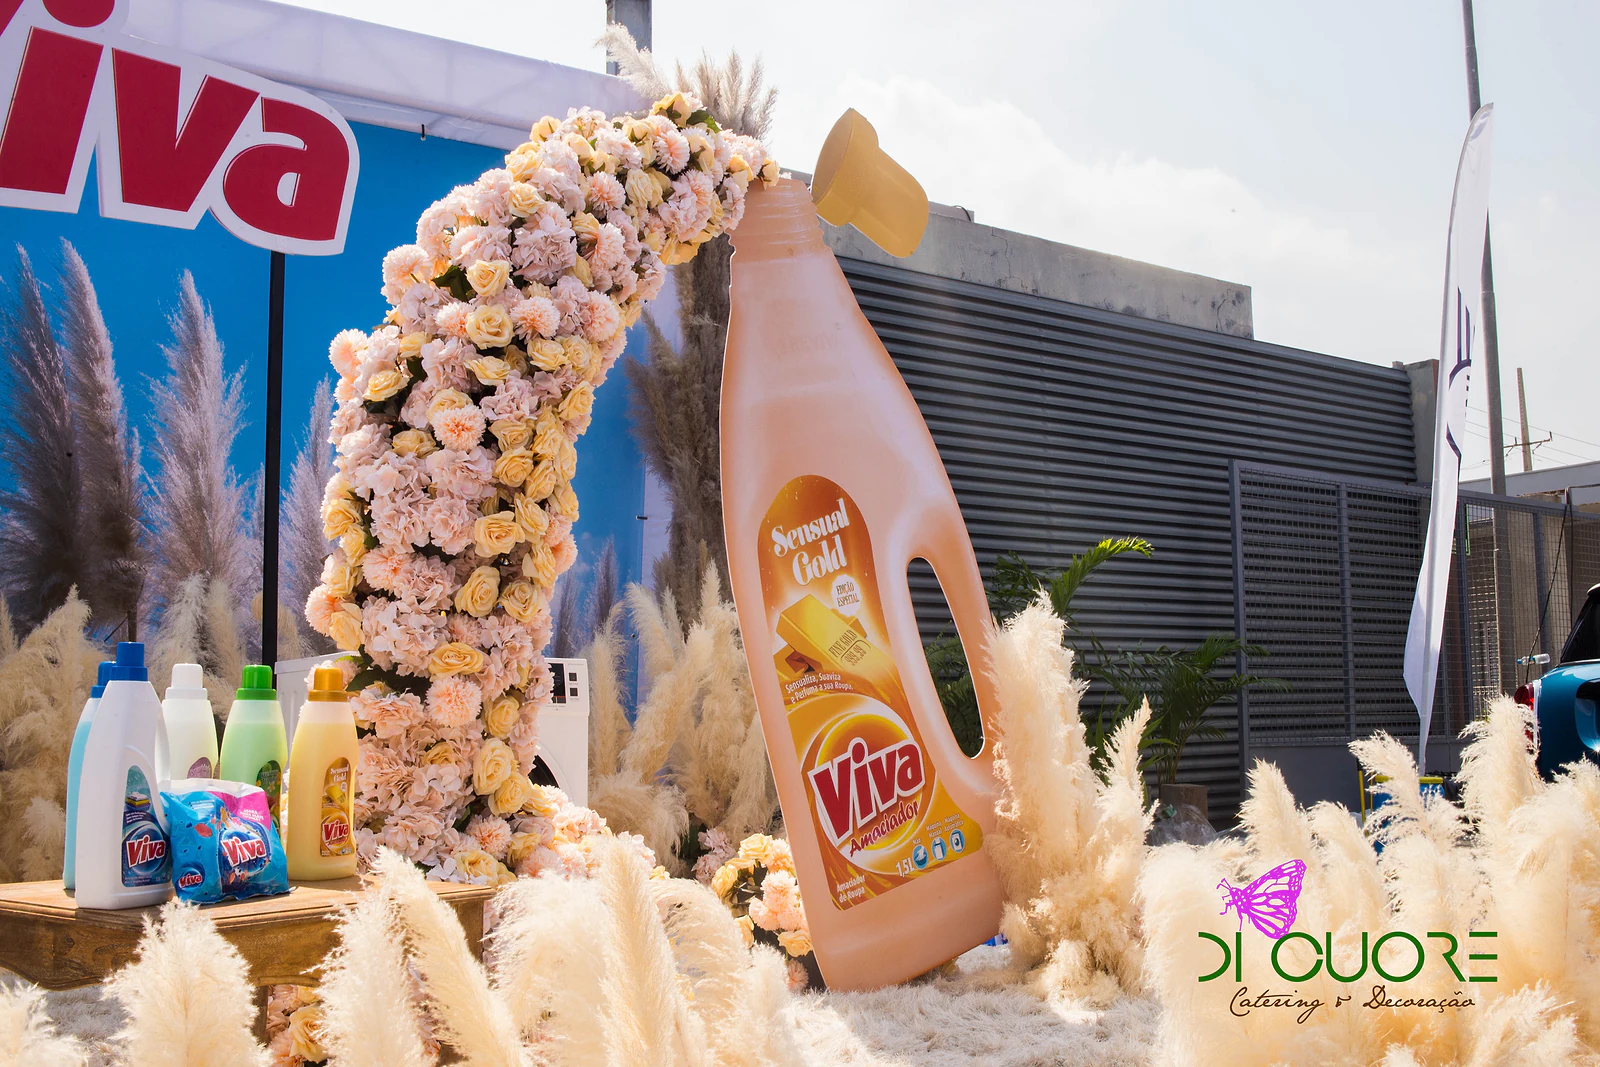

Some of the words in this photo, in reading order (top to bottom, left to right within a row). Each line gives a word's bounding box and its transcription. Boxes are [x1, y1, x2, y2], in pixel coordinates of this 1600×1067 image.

[0, 0, 350, 242] iva
[771, 497, 850, 558] Sensual
[792, 534, 848, 587] Gold
[818, 671, 841, 681] Suaviza
[790, 696, 796, 704] e
[794, 685, 819, 702] Perfuma
[818, 683, 824, 691] a
[823, 682, 834, 690] sua
[809, 739, 925, 843] Viva
[322, 820, 350, 843] Viva
[849, 799, 919, 858] Amaciador
[126, 835, 167, 868] Viva
[221, 836, 268, 868] Viva
[895, 857, 915, 878] 1,5L
[178, 873, 203, 888] Viva
[839, 893, 847, 903] de
[847, 886, 865, 899] Roupa
